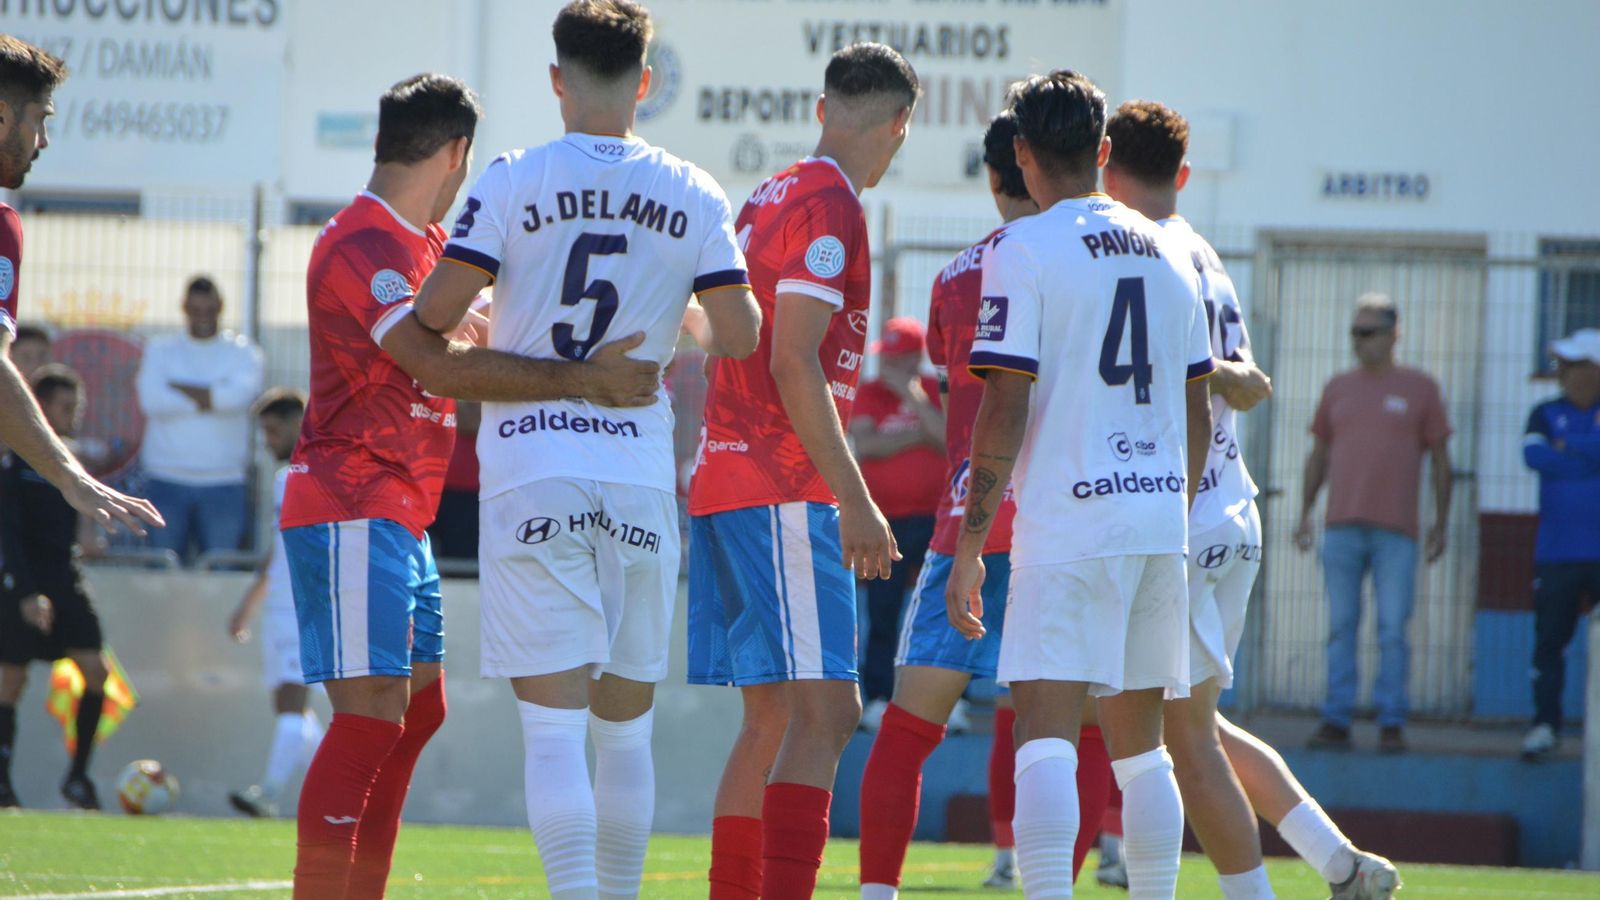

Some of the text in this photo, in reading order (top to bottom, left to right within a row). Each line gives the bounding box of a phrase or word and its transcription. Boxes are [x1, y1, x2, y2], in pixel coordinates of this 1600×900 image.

[594, 144, 625, 155] 1922
[551, 232, 628, 361] 5
[1098, 276, 1153, 404] 4
